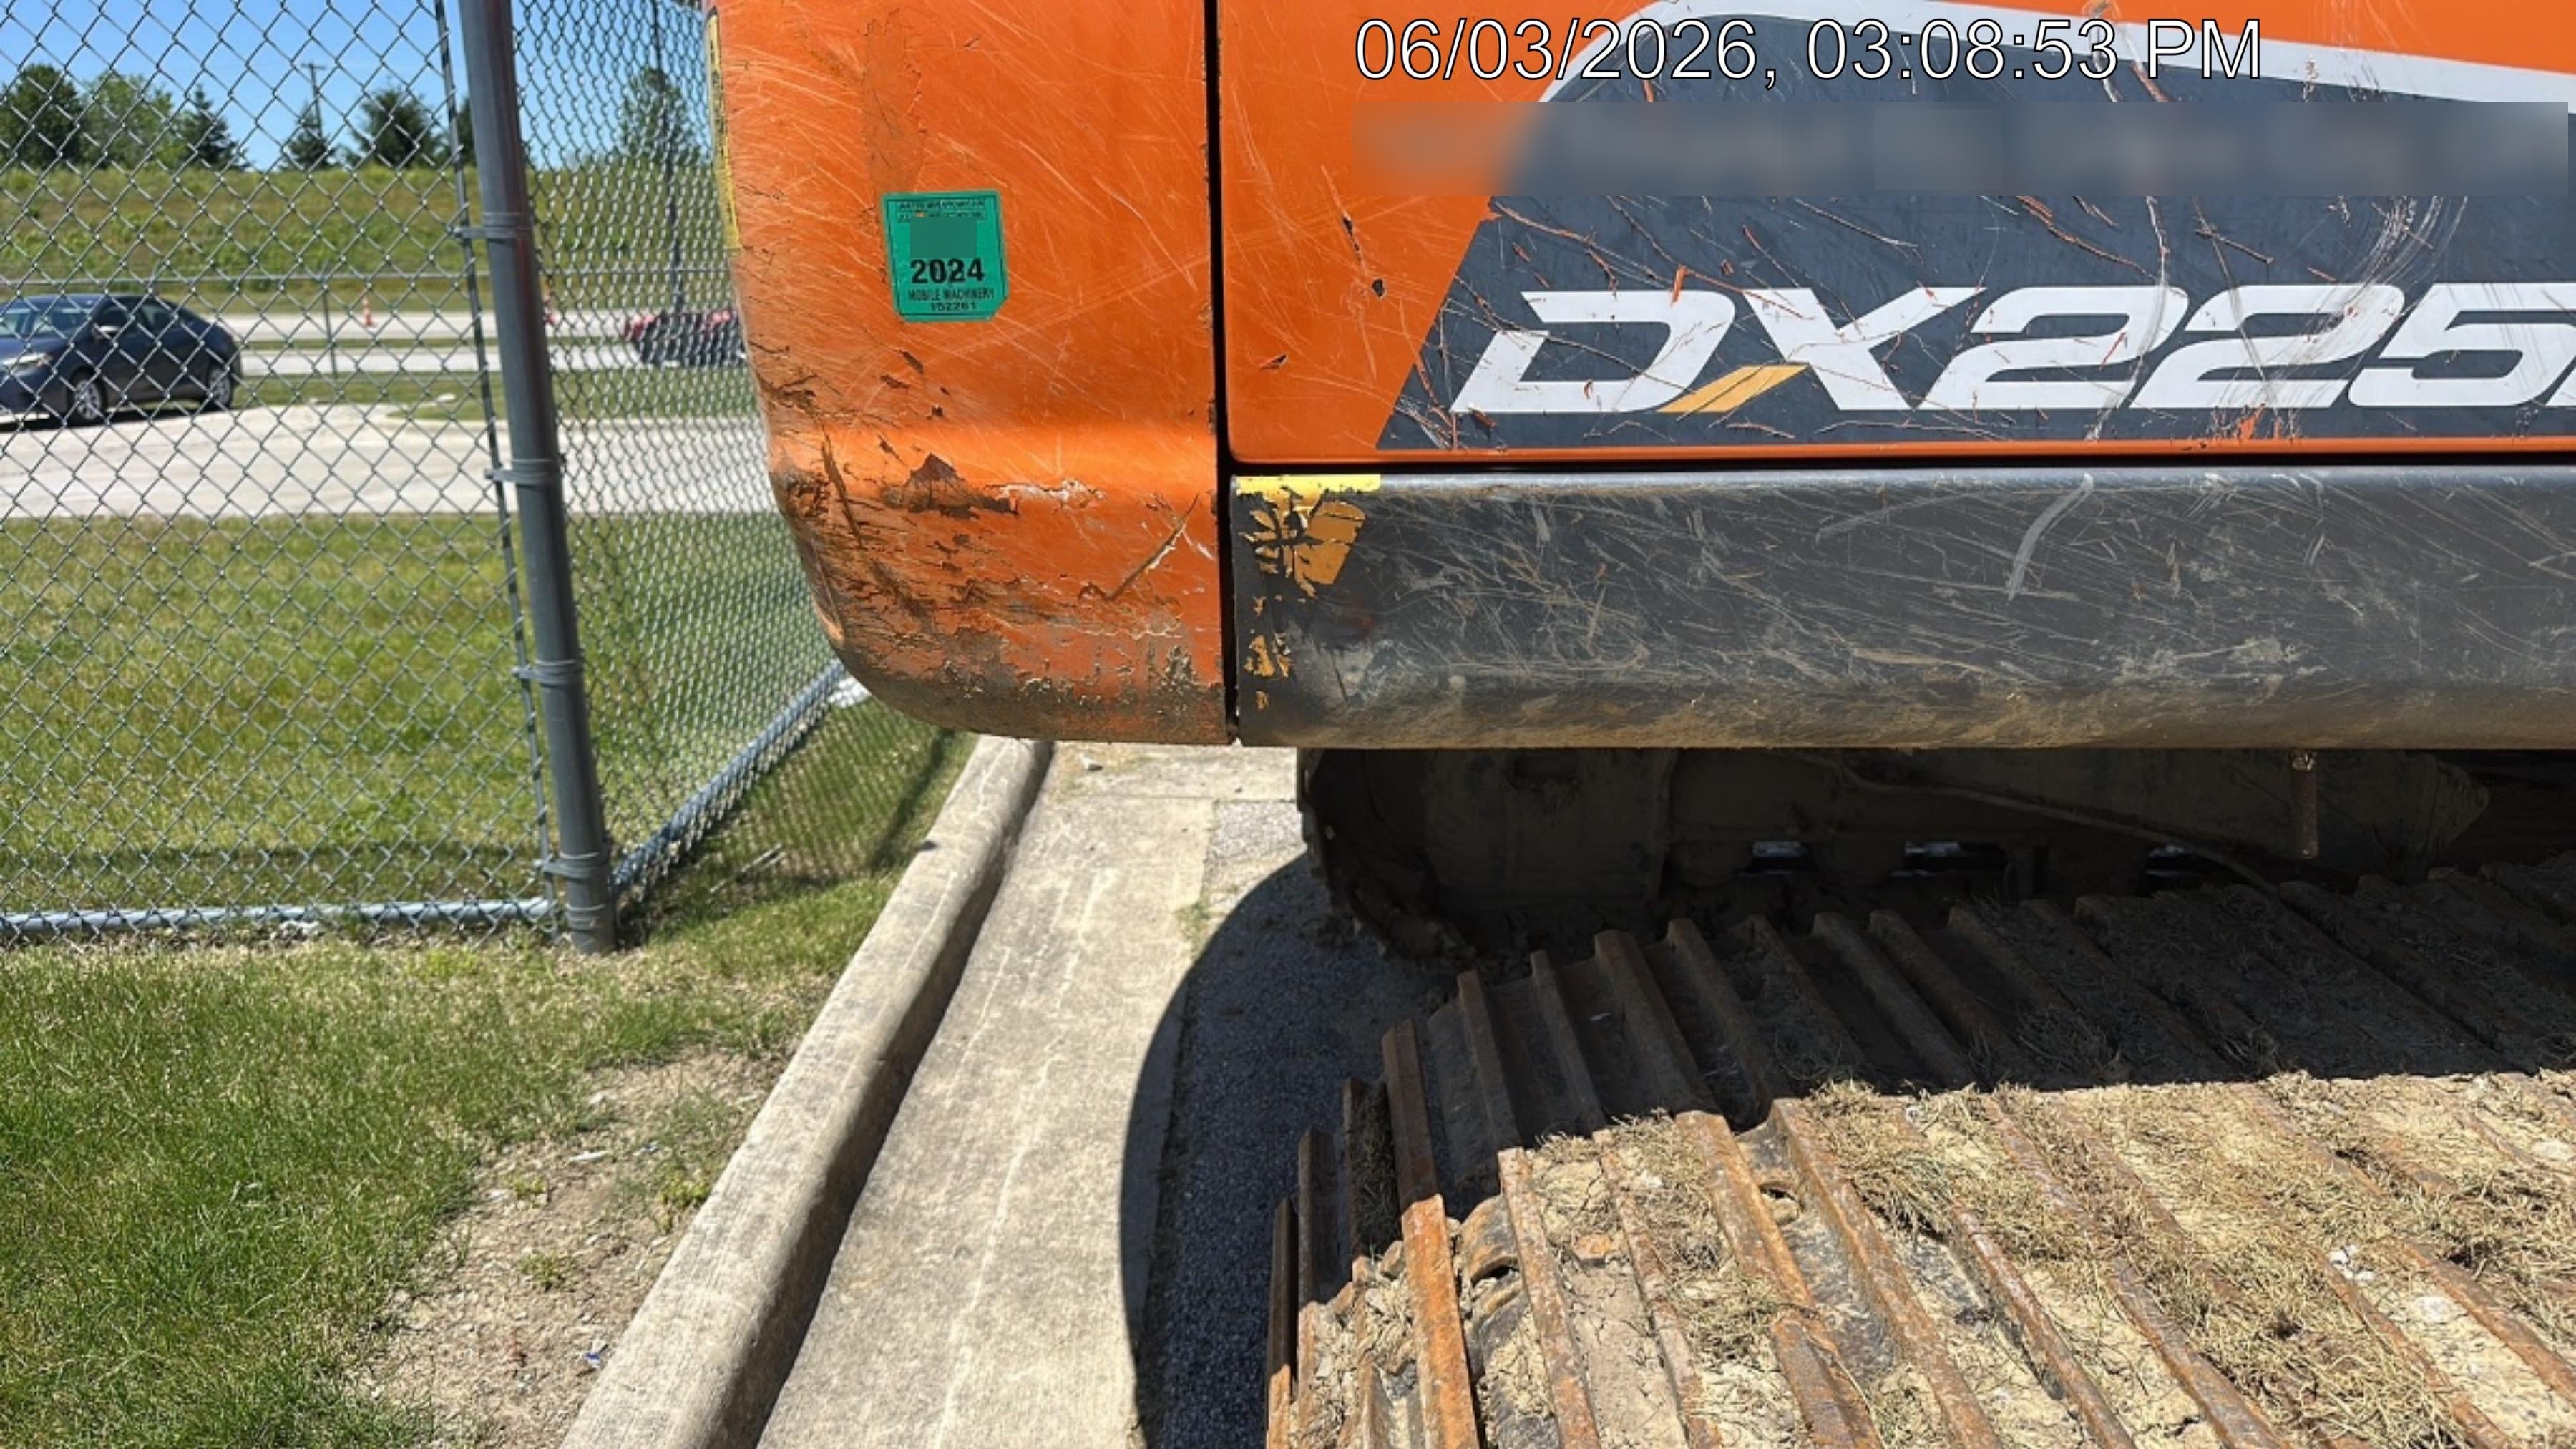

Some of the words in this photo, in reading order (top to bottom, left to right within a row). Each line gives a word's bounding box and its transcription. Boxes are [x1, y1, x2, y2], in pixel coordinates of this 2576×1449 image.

[910, 258, 985, 284] 2024
[908, 288, 940, 301] MOBILE
[944, 287, 995, 300] MACHINERY
[1449, 281, 2576, 413] DX225
